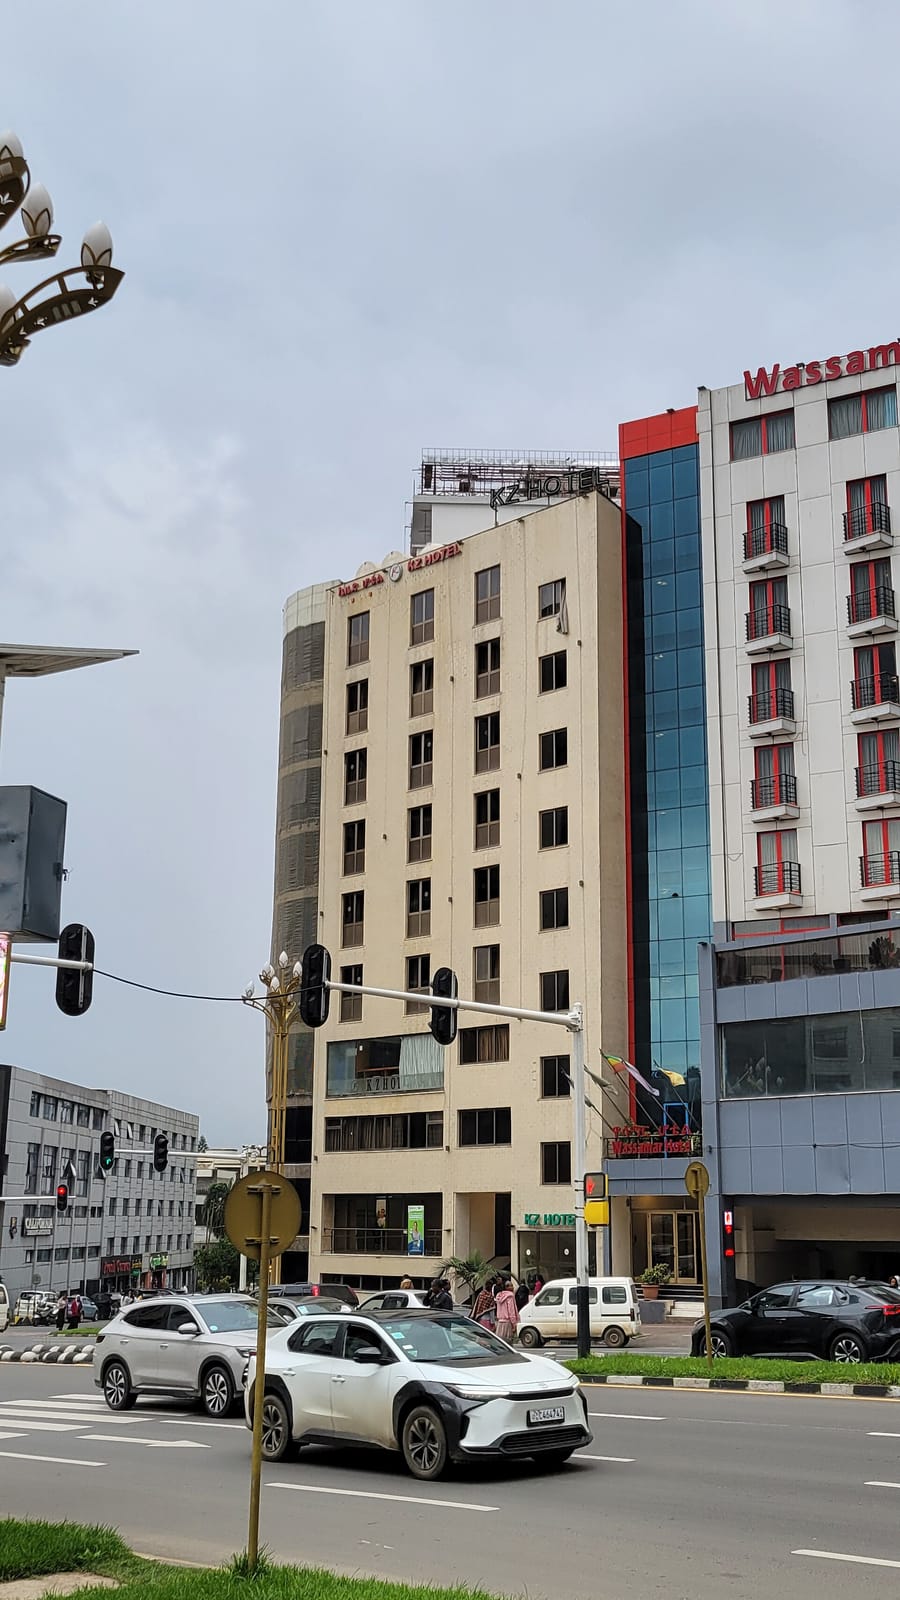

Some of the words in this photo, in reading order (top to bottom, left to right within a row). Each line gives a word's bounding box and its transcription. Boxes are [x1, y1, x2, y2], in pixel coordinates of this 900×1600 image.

[490, 484, 520, 510] KZ
[527, 466, 609, 500] HOTEL
[407, 559, 424, 572] KZ
[424, 543, 462, 566] HOTEL
[524, 1214, 540, 1225] KZ
[543, 1214, 576, 1225] HOTE
